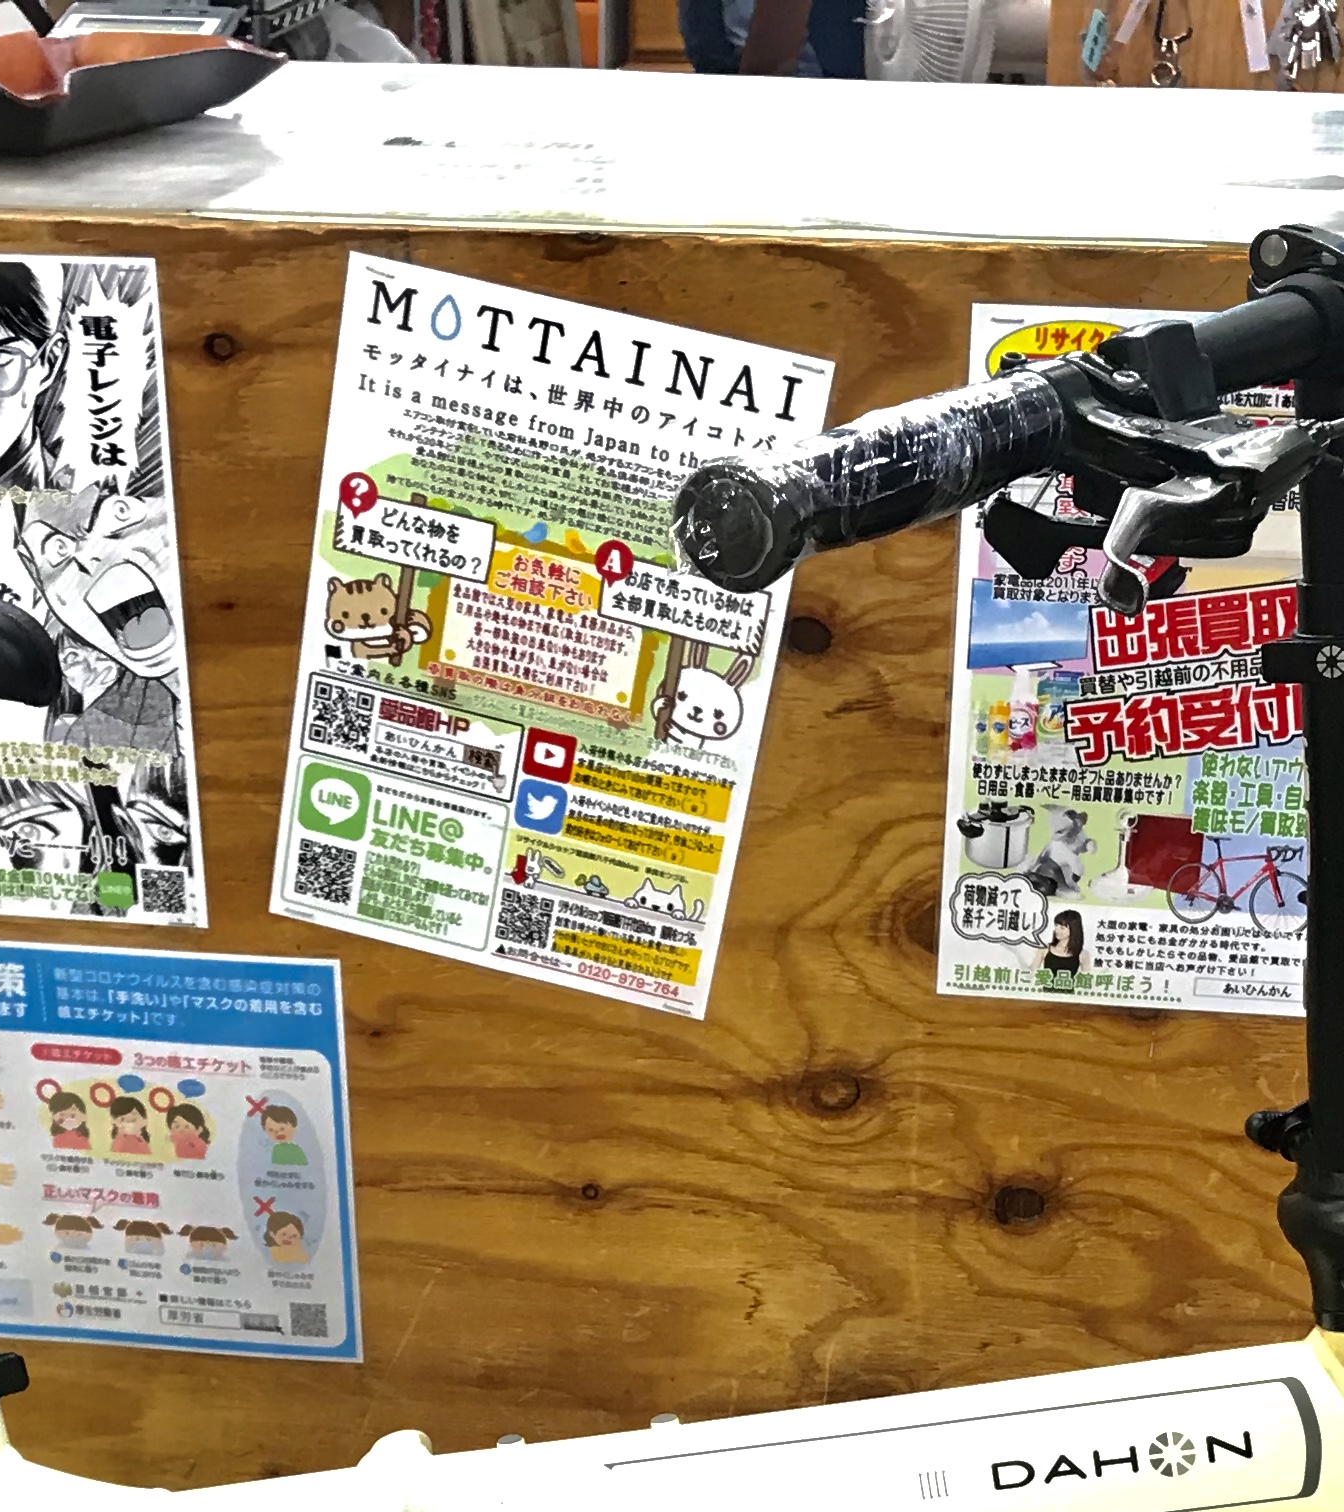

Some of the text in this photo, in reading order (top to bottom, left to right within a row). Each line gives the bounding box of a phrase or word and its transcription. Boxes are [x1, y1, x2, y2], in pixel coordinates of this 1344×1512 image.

[79, 315, 127, 467] 電子レンジは
[362, 342, 777, 452] モッタイナイは、世界中のアイコトバ
[357, 374, 379, 394] It
[384, 379, 403, 398] is
[410, 390, 423, 404] a
[430, 393, 519, 428] message
[529, 415, 576, 442] from
[583, 426, 641, 458] Japan
[650, 444, 671, 463] to
[381, 507, 461, 543] どんな物を
[349, 524, 483, 578] 買取ってくれるの?
[513, 555, 580, 585] お気軽に
[495, 568, 592, 609] ご相談下さい
[625, 570, 755, 616] お店で売っている物は
[612, 591, 755, 643] 全部買取したものだよ!
[1094, 588, 1298, 668] 出張買取
[377, 696, 470, 740] 愛品館HP
[384, 729, 458, 759] あいひんかん
[317, 789, 353, 810] LINE
[372, 798, 465, 843] LINE@
[954, 963, 1170, 996] 引越前に愛品館呼ぼう!
[1222, 981, 1292, 999] あいひんかん
